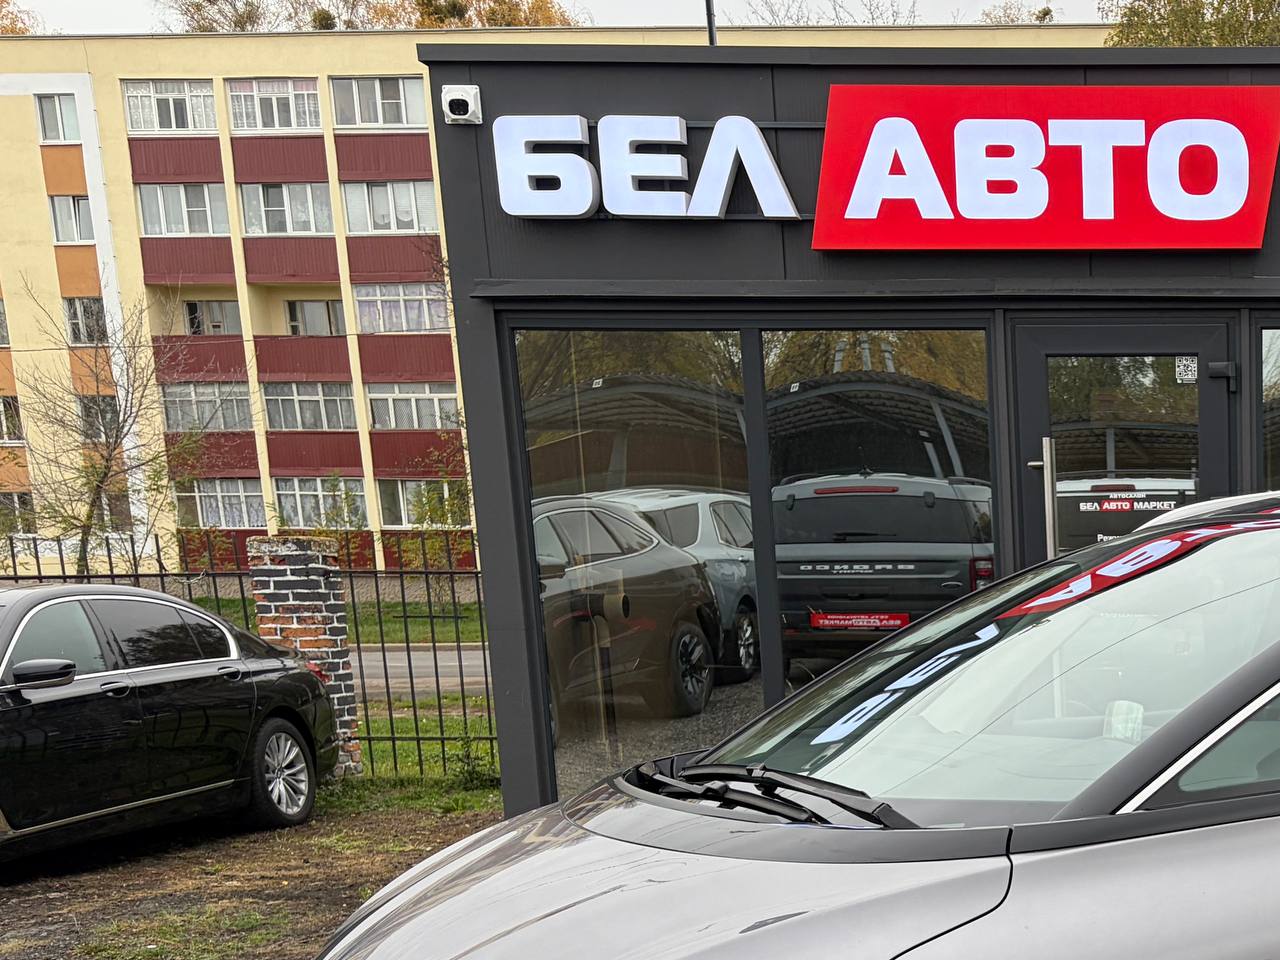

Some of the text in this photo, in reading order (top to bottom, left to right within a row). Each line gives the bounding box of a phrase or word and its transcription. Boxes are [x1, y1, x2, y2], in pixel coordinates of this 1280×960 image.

[492, 114, 801, 220] БЕЛ
[844, 117, 1250, 221] АВТО
[1079, 501, 1176, 510] БЕЛ АВТО МАРКЕТ
